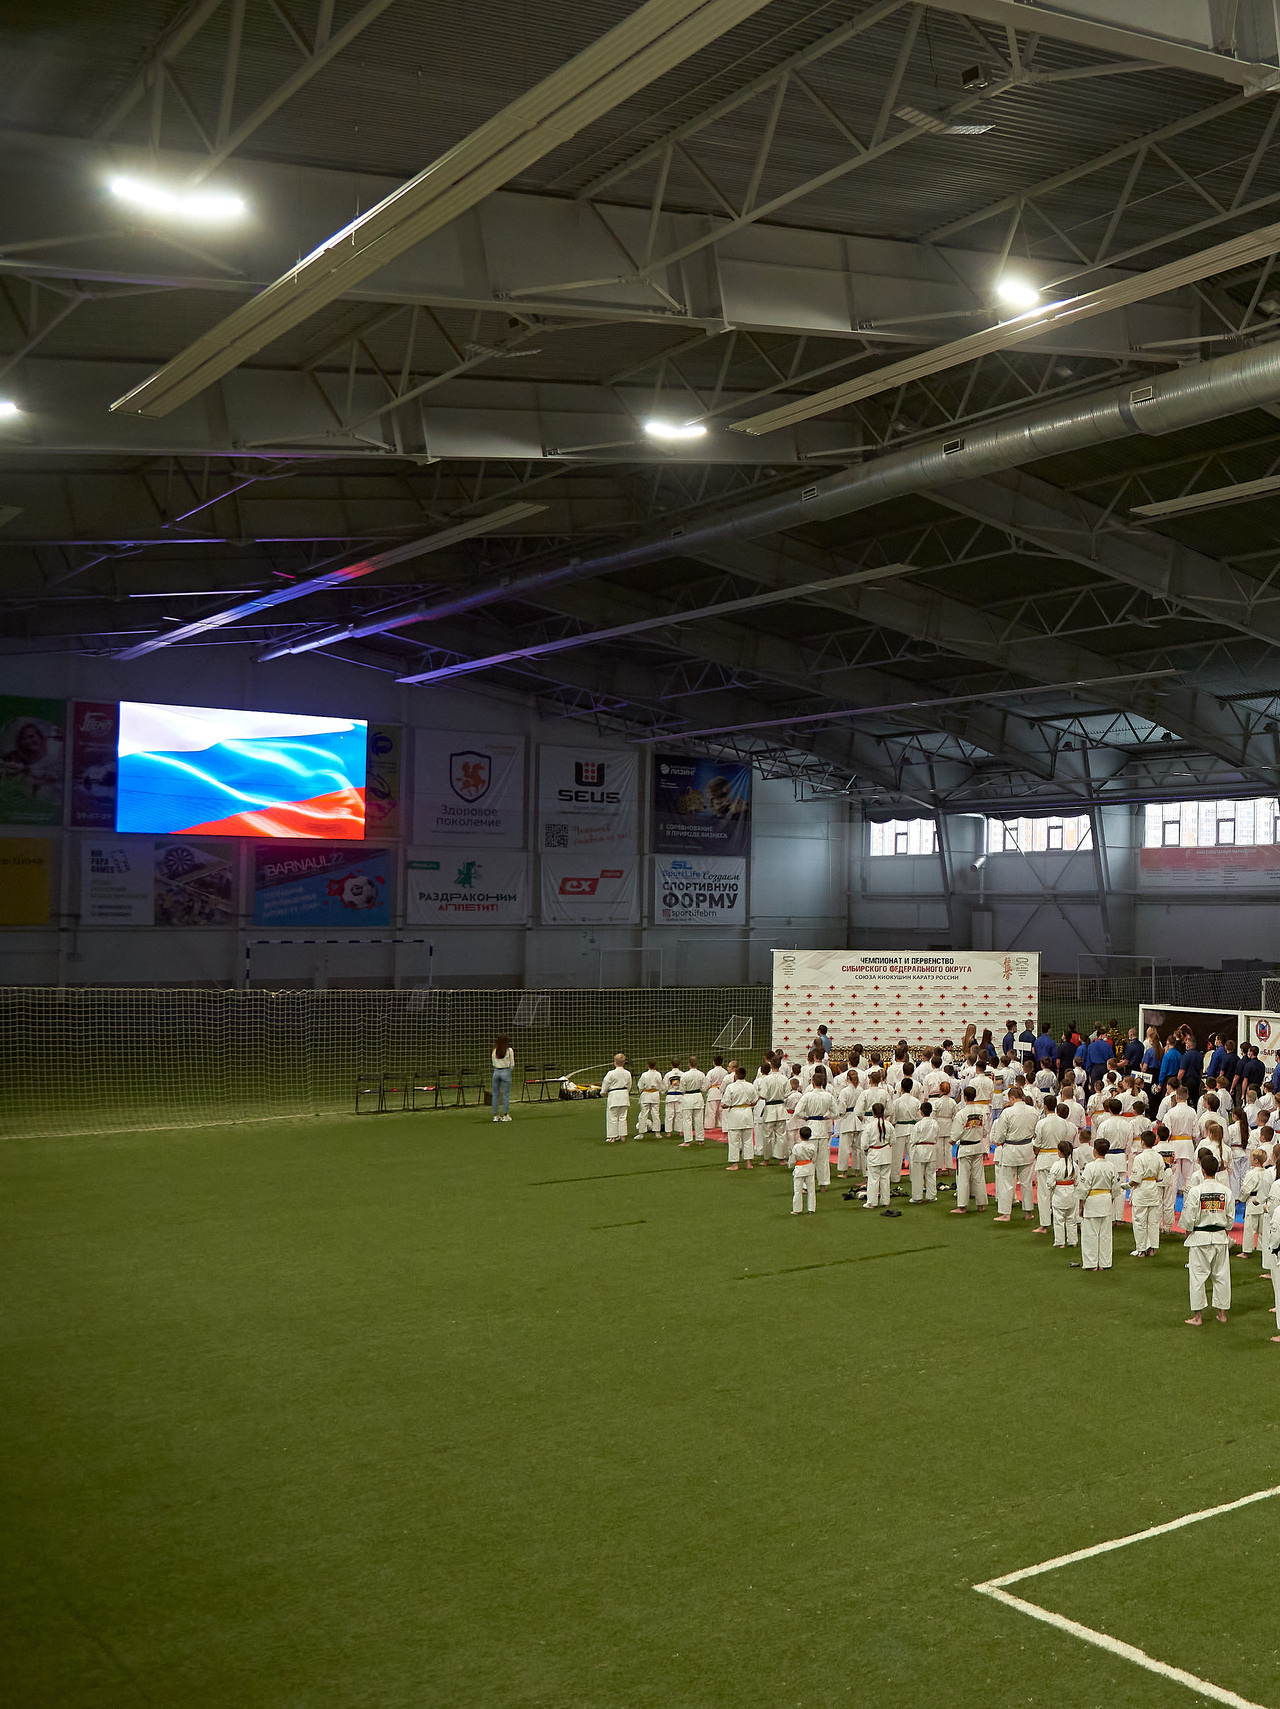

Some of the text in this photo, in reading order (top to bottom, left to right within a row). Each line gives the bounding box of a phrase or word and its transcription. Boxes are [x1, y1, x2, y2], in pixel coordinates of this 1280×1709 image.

[558, 789, 620, 803] SEUS
[441, 804, 498, 817] Здоровое
[436, 817, 502, 827] поколение
[662, 881, 739, 892] СПОРТИВНУЮ
[418, 892, 517, 902] РАЗДРАКОНИМ
[662, 892, 738, 909] ФОРМУ
[438, 903, 499, 911] АППЕТИТ!
[860, 957, 954, 965] ЧЕМПИОНАТ И ПЕРВЕНСТВО
[841, 965, 972, 974] СИБИРСКОГО ФЕДЕРАЛЬНОГО ОКРУГА
